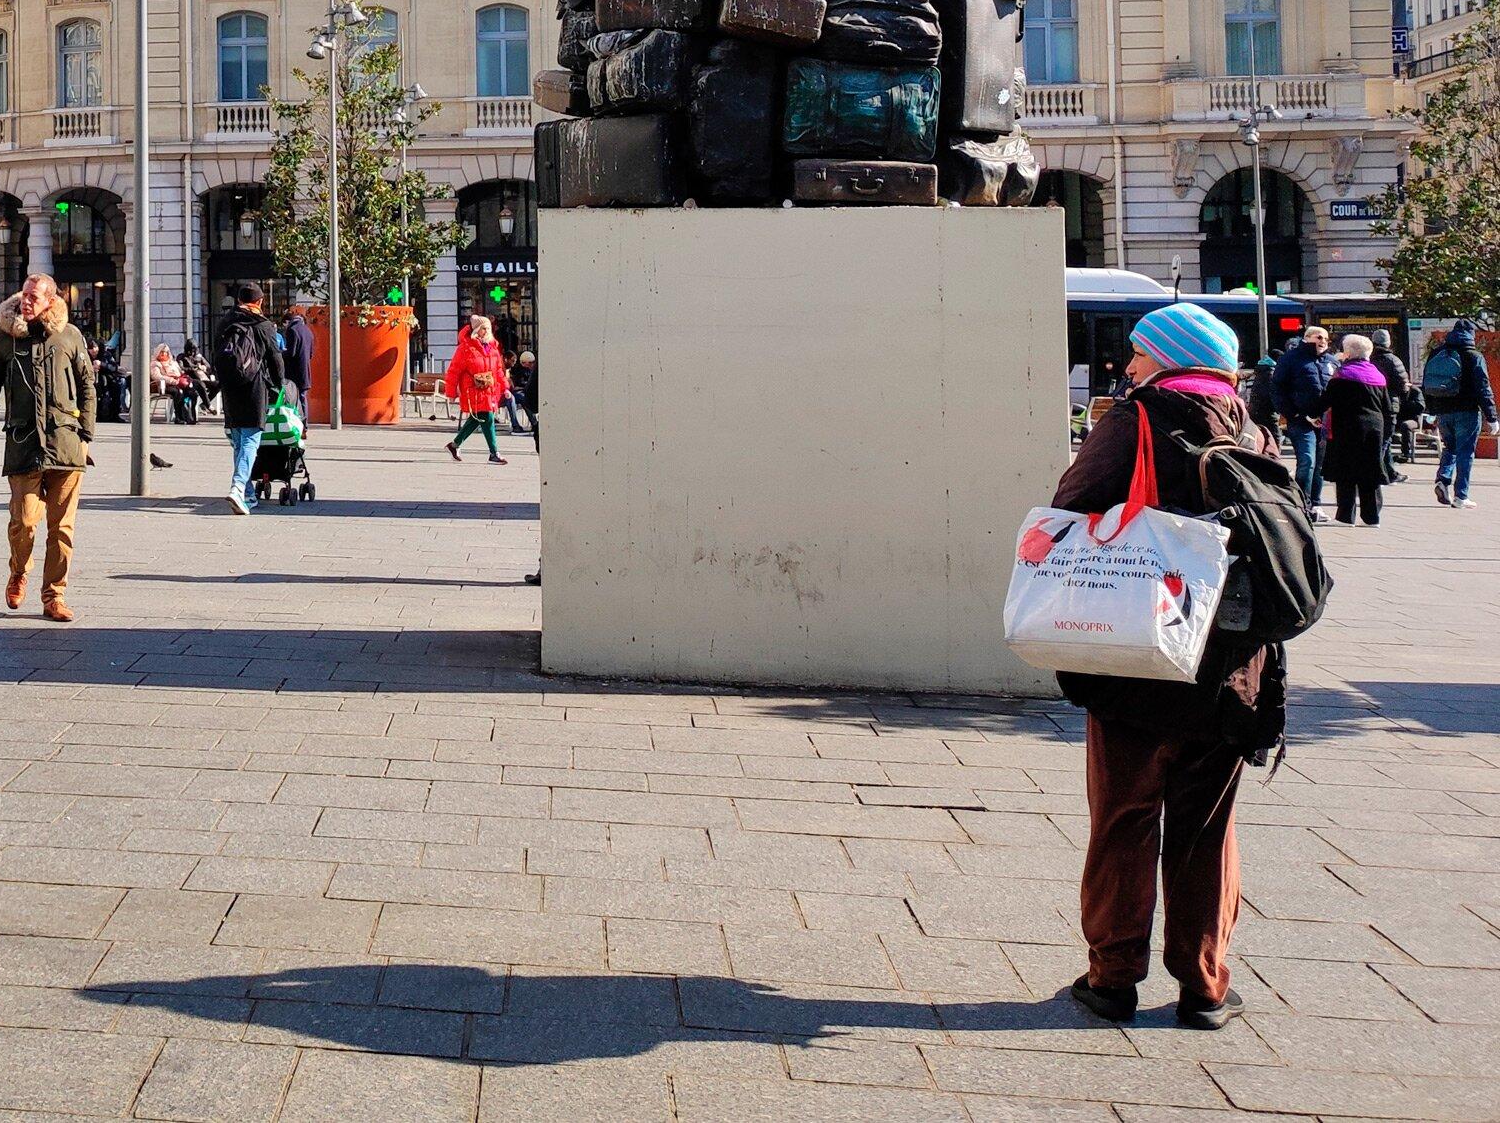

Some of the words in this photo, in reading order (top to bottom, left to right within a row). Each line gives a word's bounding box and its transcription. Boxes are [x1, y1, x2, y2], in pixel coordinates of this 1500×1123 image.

[1332, 204, 1357, 216] COUR
[483, 262, 538, 273] BAILL
[1113, 557, 1136, 565] tout
[1062, 577, 1086, 588] chez
[1087, 580, 1118, 590] nous.
[1054, 620, 1114, 633] MONOPRIX
